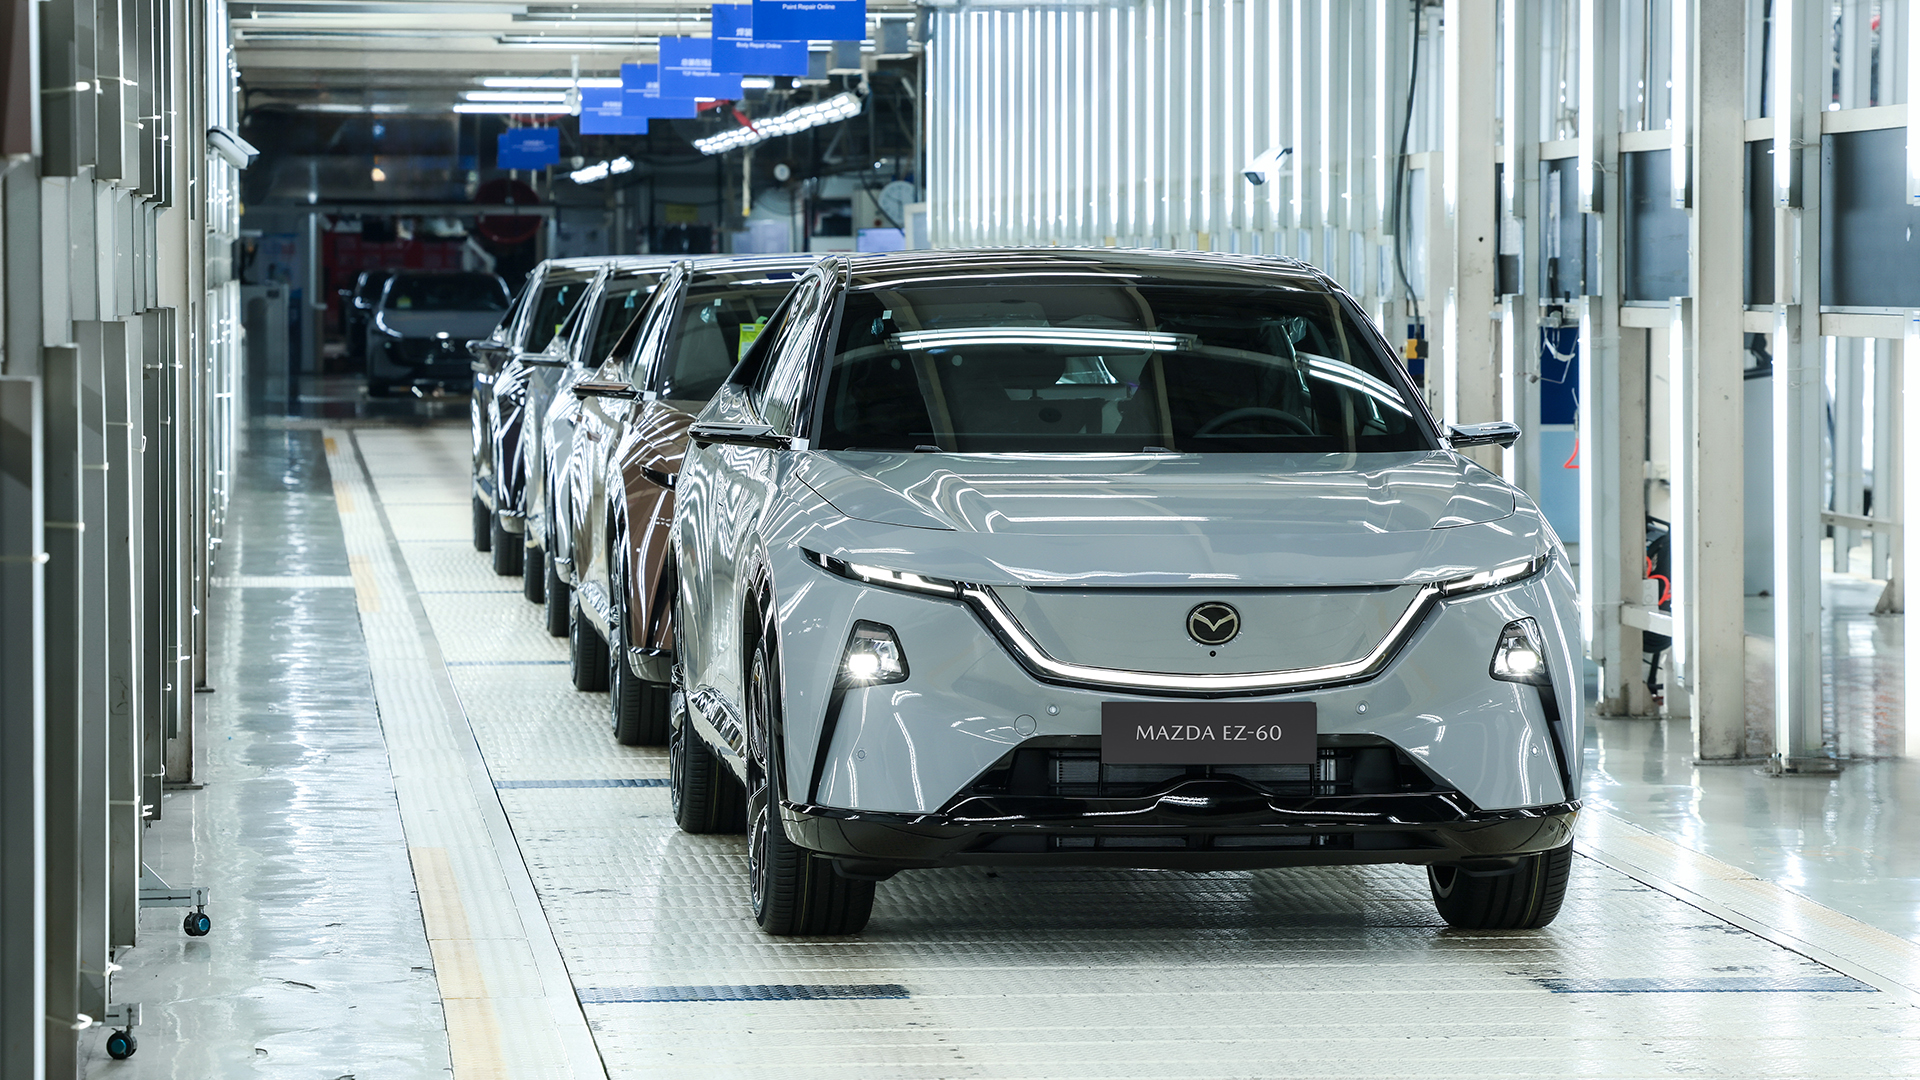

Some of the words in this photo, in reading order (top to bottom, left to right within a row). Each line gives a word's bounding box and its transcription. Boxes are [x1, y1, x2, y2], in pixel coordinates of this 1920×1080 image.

[798, 3, 816, 11] Repair
[1136, 725, 1215, 741] MAZDA
[1223, 725, 1282, 741] EZ-60
